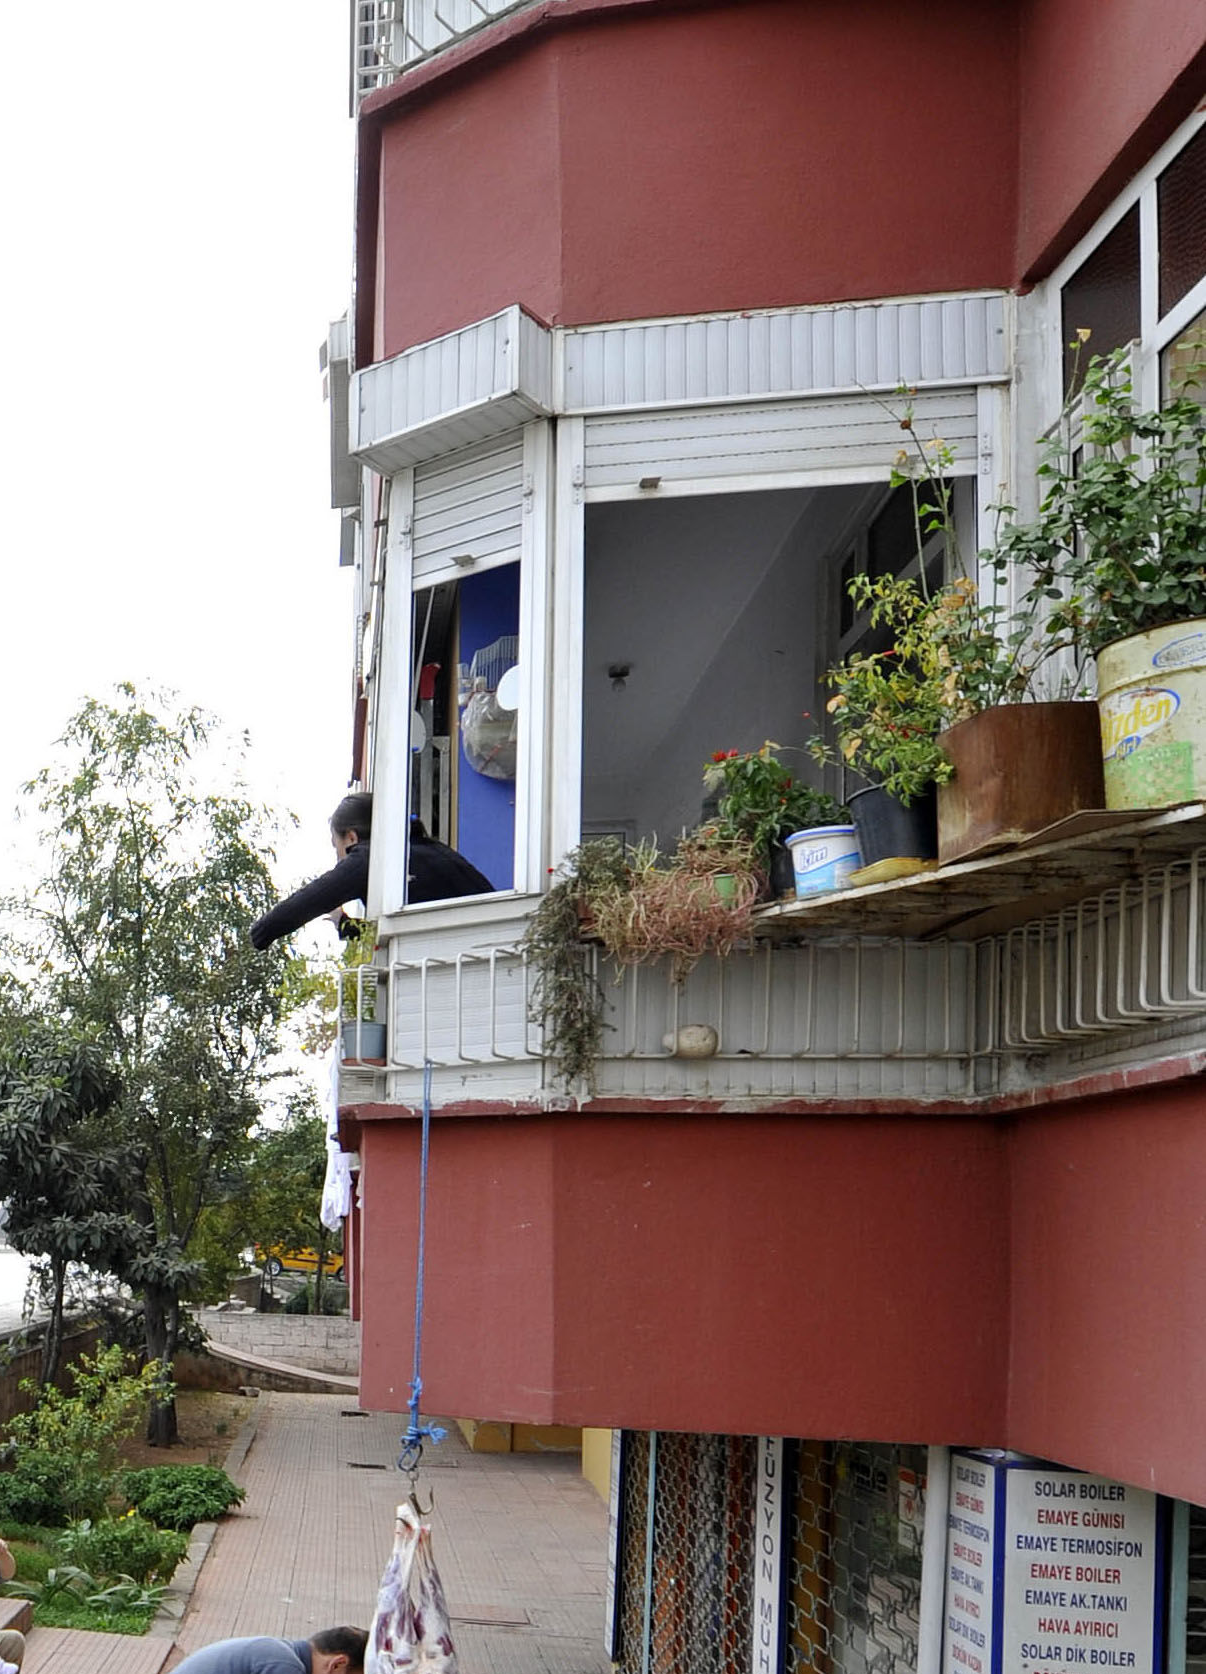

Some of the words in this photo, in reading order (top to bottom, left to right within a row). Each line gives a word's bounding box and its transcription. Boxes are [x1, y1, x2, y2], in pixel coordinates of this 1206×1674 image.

[1034, 1481, 1076, 1499] SOLAR
[1037, 1509, 1079, 1526] EMAYE
[1016, 1534, 1058, 1552] EMAYE
[1061, 1537, 1142, 1558] TERMOSİFON
[1030, 1563, 1072, 1581] EMAYE
[1025, 1589, 1067, 1607] EMAYE
[1070, 1593, 1127, 1612] AK.TANKI
[1038, 1617, 1071, 1634] HAVA
[1073, 1620, 1118, 1638] AYIRICI
[1021, 1643, 1062, 1661] SOLAR
[1066, 1644, 1087, 1664] DİK
